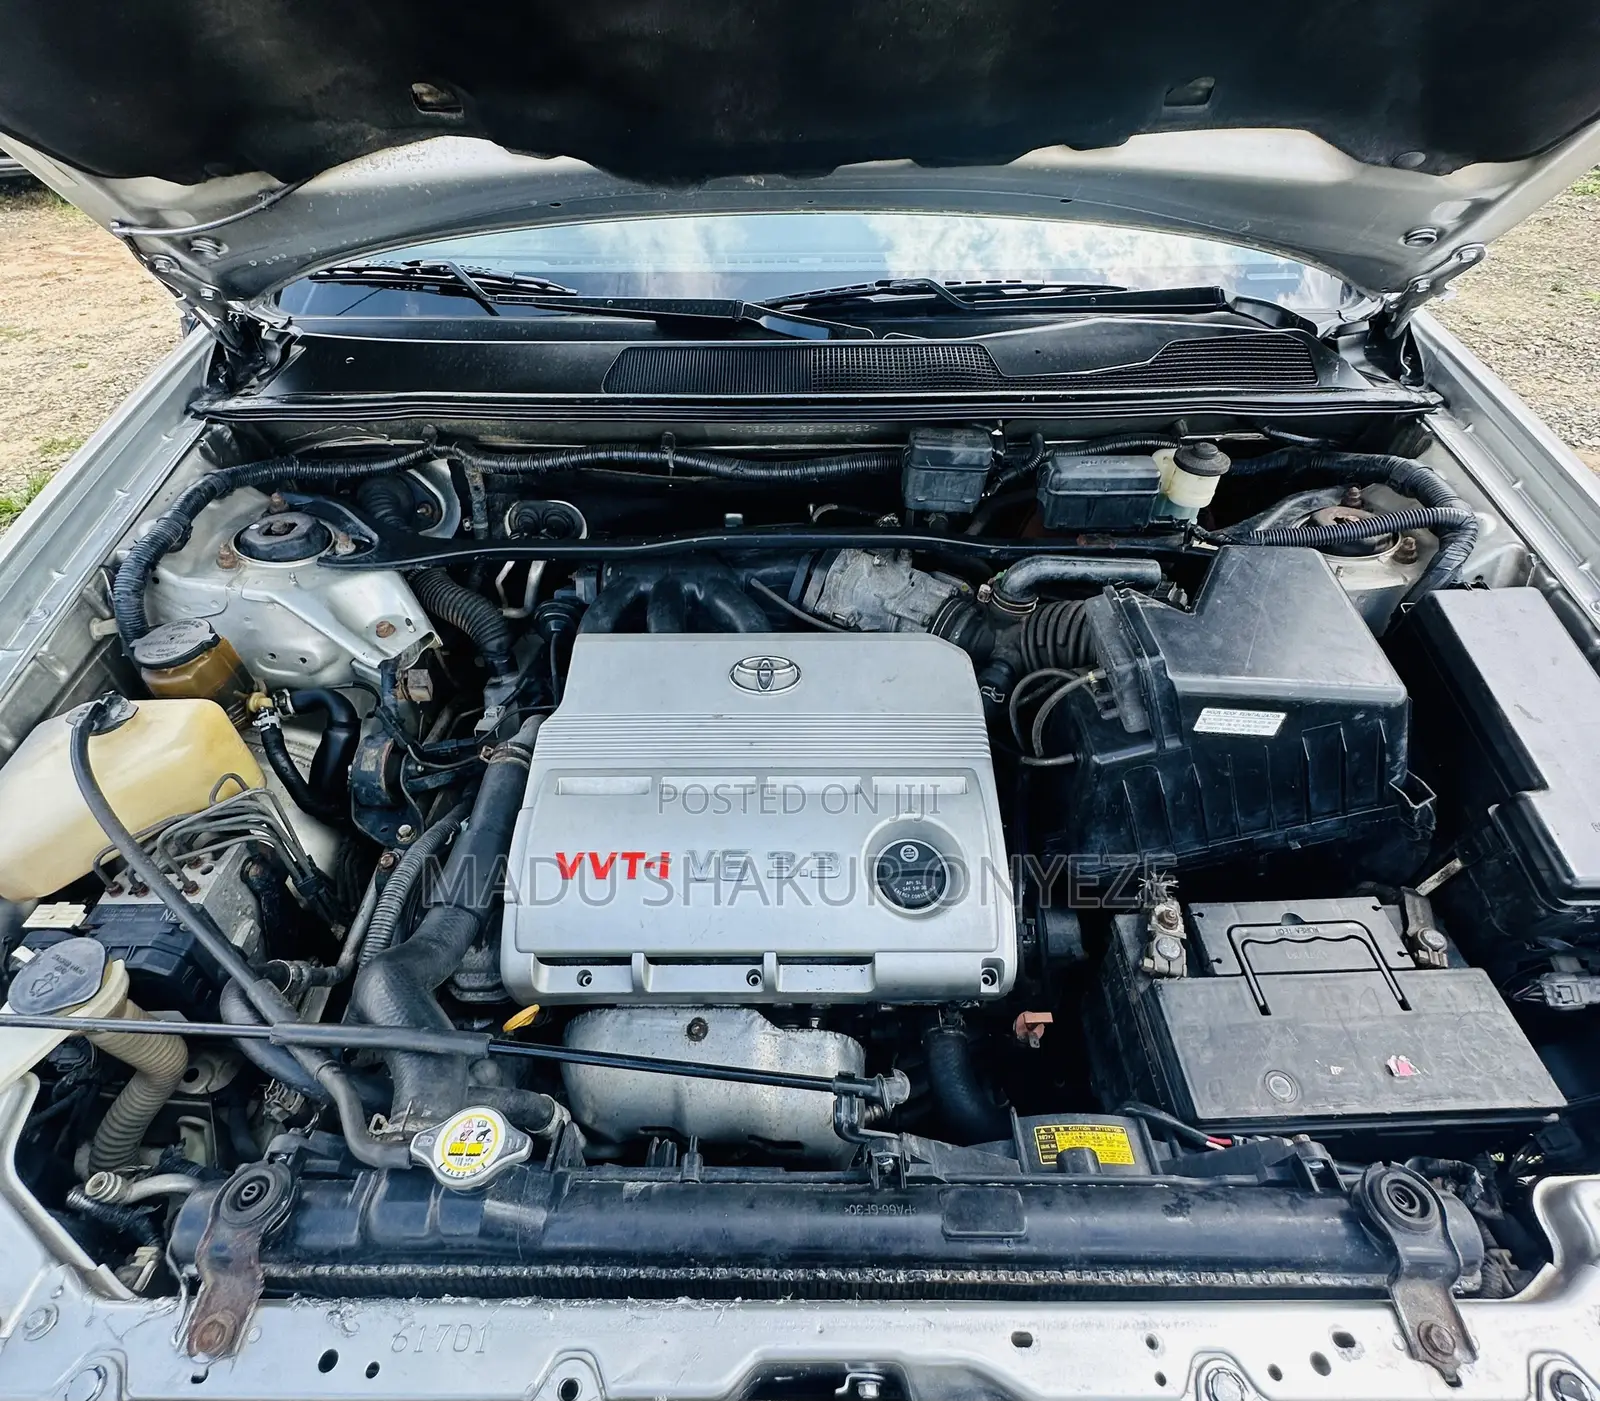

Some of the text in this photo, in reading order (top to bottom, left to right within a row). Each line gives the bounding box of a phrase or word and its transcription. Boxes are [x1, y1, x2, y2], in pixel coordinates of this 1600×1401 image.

[556, 849, 841, 881] VVT-i V6 3.3
[391, 1321, 487, 1354] 61701
